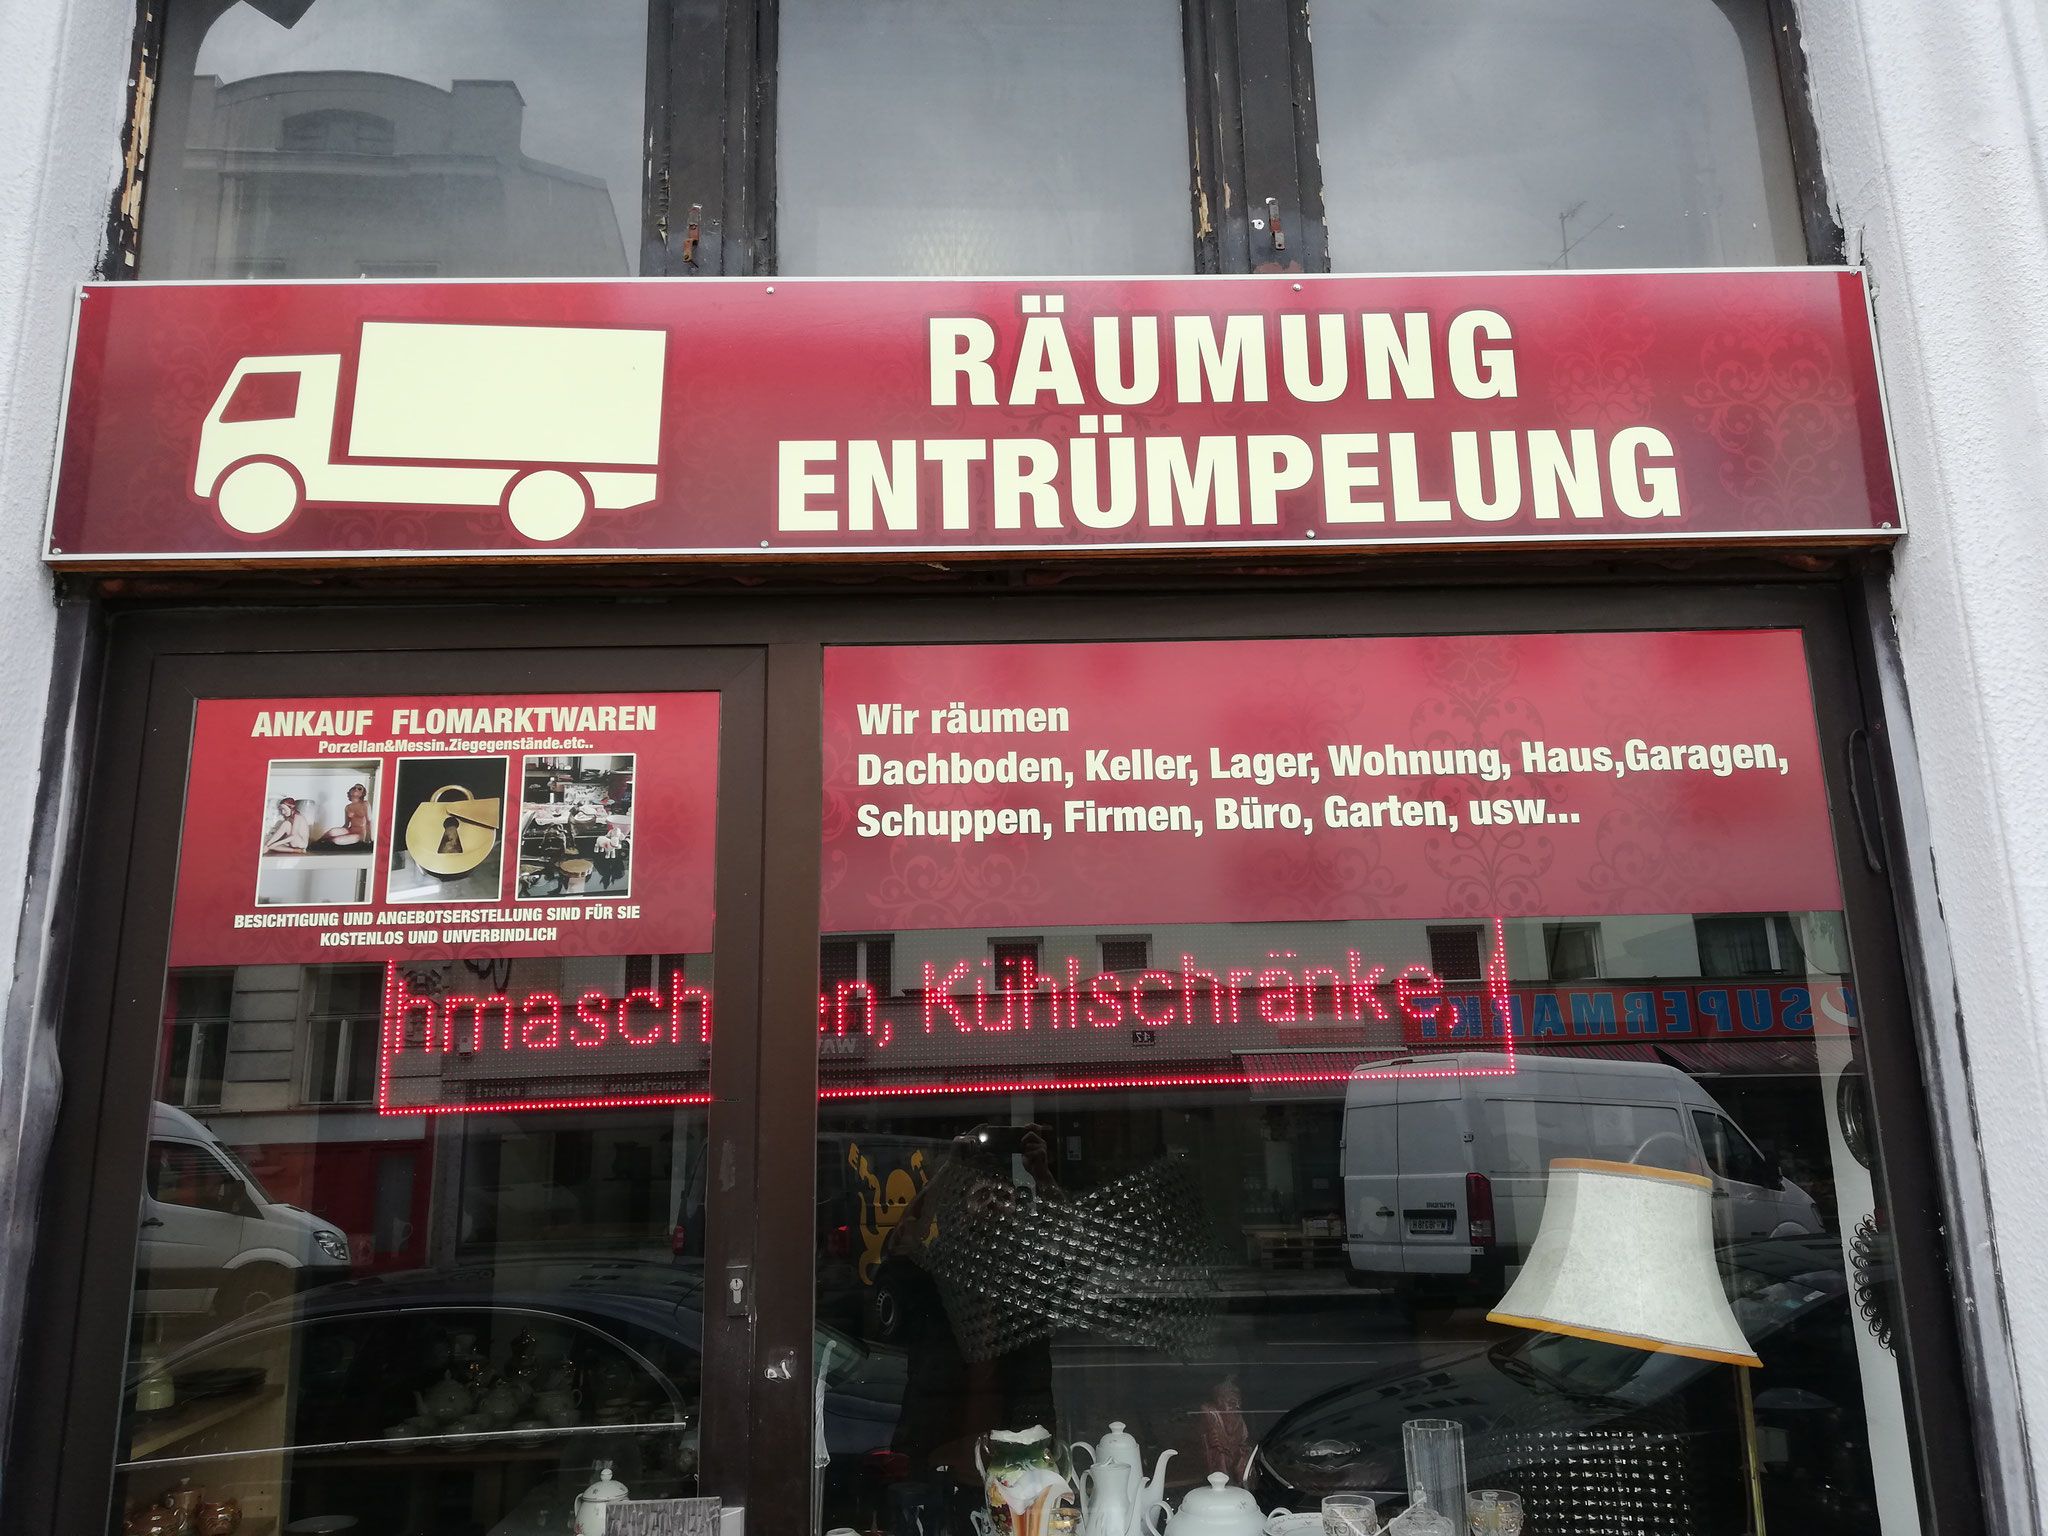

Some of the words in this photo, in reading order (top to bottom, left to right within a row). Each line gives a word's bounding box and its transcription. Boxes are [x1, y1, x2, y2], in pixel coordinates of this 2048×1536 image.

[929, 294, 1518, 406] RÄUMUNG
[777, 413, 1682, 532] ENTRÜMPELUNG
[250, 709, 374, 738] ANKAUF
[391, 705, 657, 735] FLOMARKTWAREN
[856, 703, 920, 736] Wir
[931, 701, 1070, 735] räumen
[858, 751, 1074, 789] Dachboden,
[1085, 748, 1199, 787] Keller,
[1209, 747, 1320, 786] Lager,
[1327, 743, 1512, 782] Wohnung,
[857, 803, 1053, 843] Schuppen,
[1064, 799, 1204, 838] Firmen,
[1214, 796, 1313, 836] Büro,
[1324, 794, 1459, 833] Garten,
[1468, 798, 1581, 826] usw...
[233, 912, 340, 929] BESICHTIGUNG
[342, 911, 374, 927] UND
[376, 908, 543, 925] ANGEBOTSERSTELLUNG
[546, 906, 582, 921] SIND
[584, 903, 614, 920] FÜR
[616, 905, 641, 920] SIE
[319, 931, 404, 947] KOSTENLOS
[407, 929, 439, 945] UND
[442, 926, 558, 944] UNVERBINDLICH
[922, 949, 1461, 1035] Kühlschränke,
